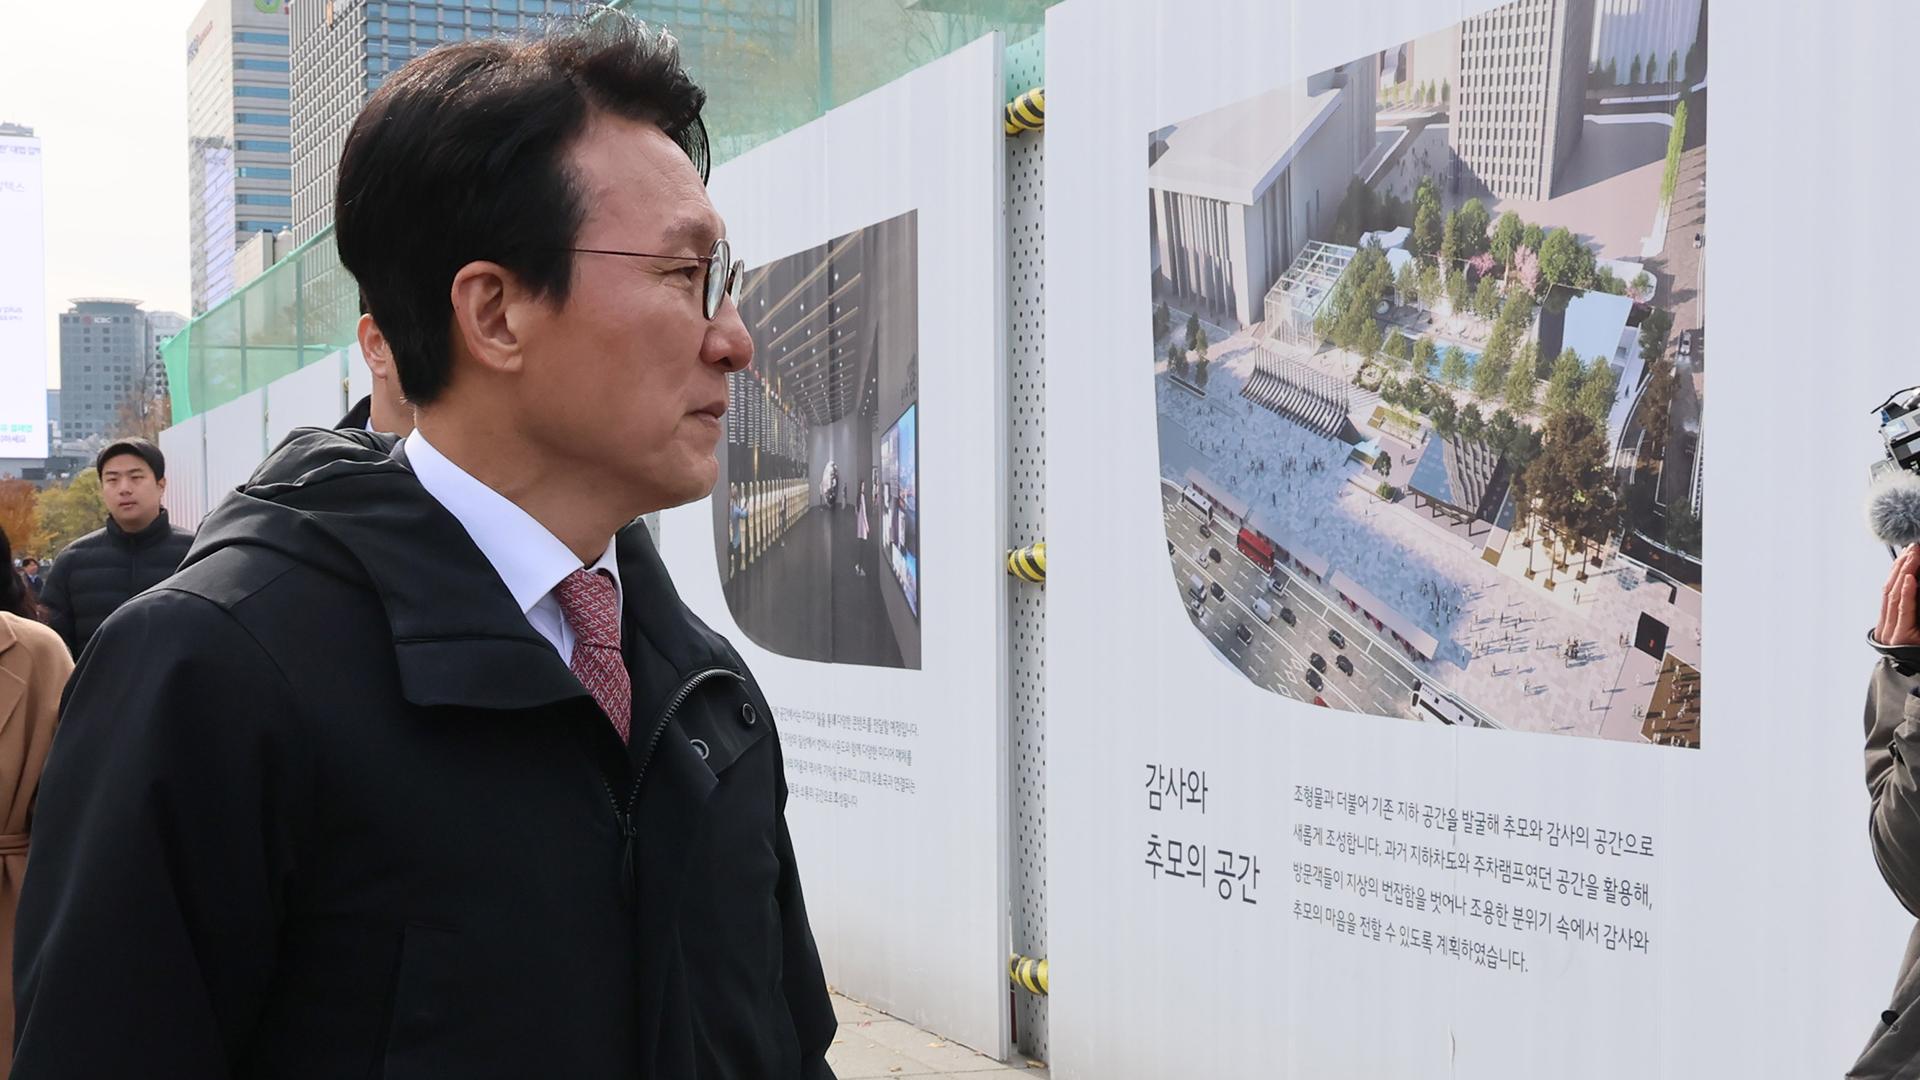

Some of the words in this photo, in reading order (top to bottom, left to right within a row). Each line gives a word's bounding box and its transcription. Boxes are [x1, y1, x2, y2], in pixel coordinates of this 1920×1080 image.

[1145, 764, 1208, 815] 감사와
[1293, 785, 1334, 810] 조형물과
[1337, 791, 1369, 816] 더불어
[1372, 797, 1394, 821] 기존
[1397, 801, 1420, 823] 지하
[1422, 804, 1459, 832] 공간을
[1462, 810, 1500, 836] 발굴해
[1503, 815, 1543, 842] 추모와
[1546, 822, 1590, 849] 감사의
[1594, 828, 1654, 857] 공간으로
[1145, 834, 1206, 888] 추모의
[1214, 849, 1260, 905] 공간
[1293, 823, 1323, 847] 새롭게
[1326, 829, 1382, 856] 조성합니다.
[1384, 839, 1407, 863] 과거
[1410, 845, 1470, 874] 지하차도와
[1473, 855, 1552, 891] 주차램프였던
[1556, 869, 1599, 900] 공간을
[1603, 876, 1653, 911] 활용해,
[1293, 861, 1344, 890] 방문객들이
[1346, 873, 1379, 898] 지상의
[1382, 879, 1427, 911] 번잡함을
[1430, 890, 1467, 916] 벗어나
[1470, 898, 1509, 928] 조용한
[1512, 906, 1552, 935] 분위기
[1556, 915, 1599, 944] 속에서
[1603, 924, 1650, 954] 감사와
[1293, 899, 1323, 925] 추모의
[1325, 907, 1356, 935] 마음을
[1359, 915, 1382, 942] 전할
[1385, 922, 1396, 943] 수
[1400, 925, 1433, 955] 있도록
[1436, 934, 1529, 973] 계획하였습니다.
